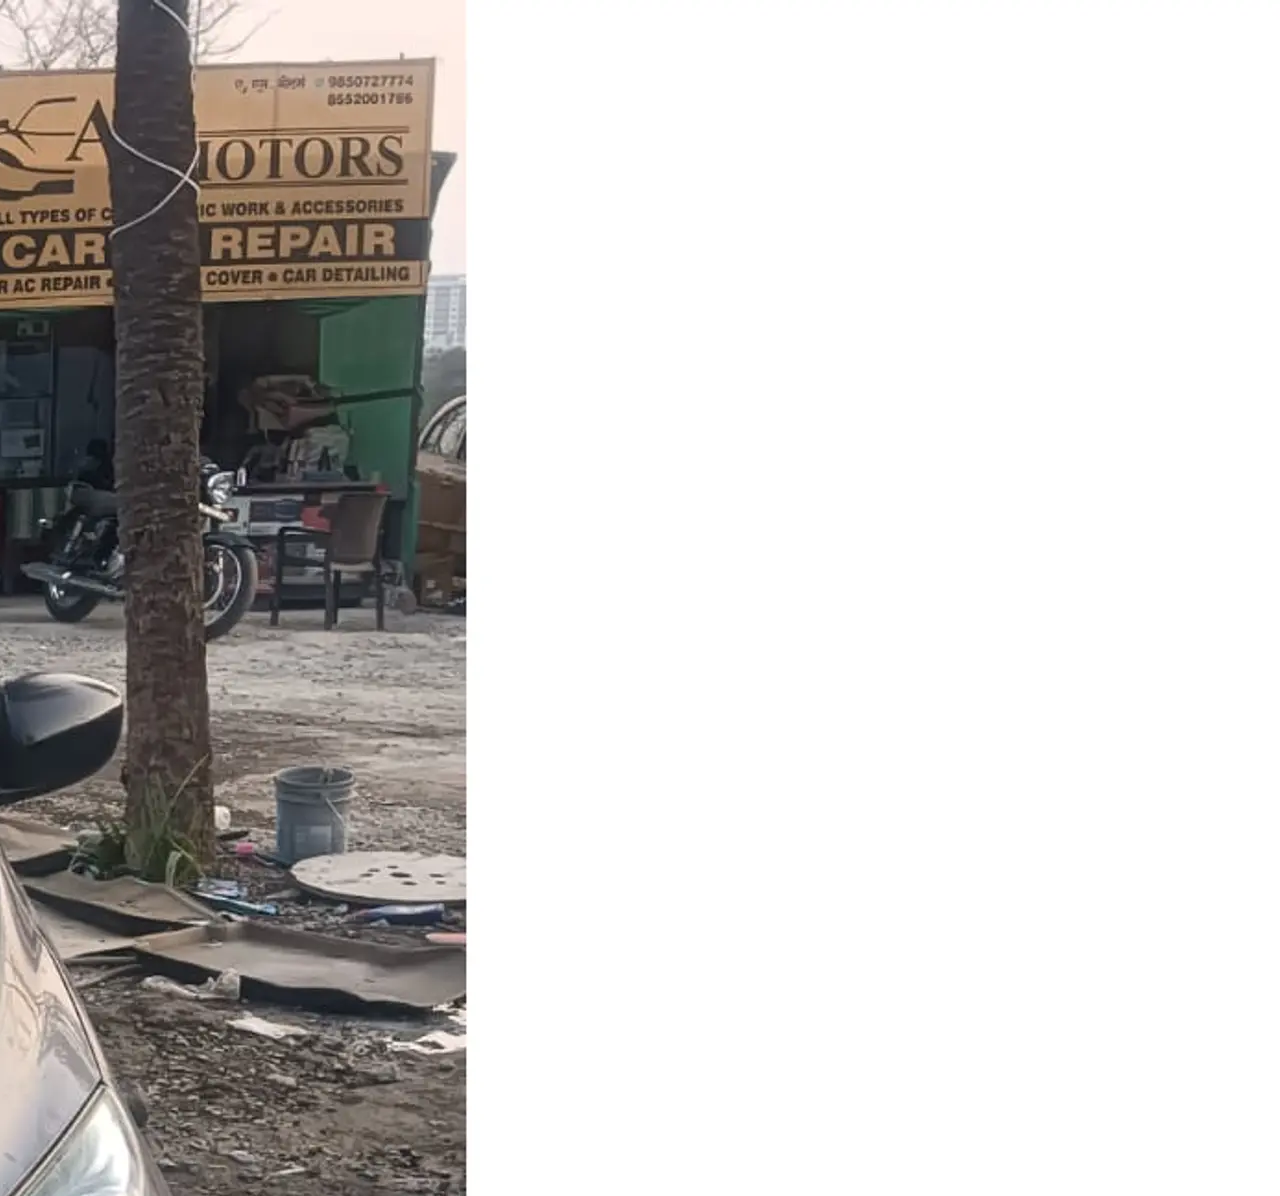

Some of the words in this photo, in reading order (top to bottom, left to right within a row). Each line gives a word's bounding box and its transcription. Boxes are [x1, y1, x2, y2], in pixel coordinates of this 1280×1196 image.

[20, 209, 70, 223] TYPES
[74, 208, 97, 222] OF
[221, 201, 269, 217] WORK
[274, 201, 286, 215] &
[291, 198, 404, 215] ACCESSORIES
[1, 232, 105, 269] CAR
[209, 222, 396, 260] REPAIR
[13, 278, 37, 293] AC
[41, 275, 101, 291] REPAIR
[206, 268, 263, 286] COVER
[283, 268, 316, 283] CAR
[322, 265, 411, 282] DETAILING
